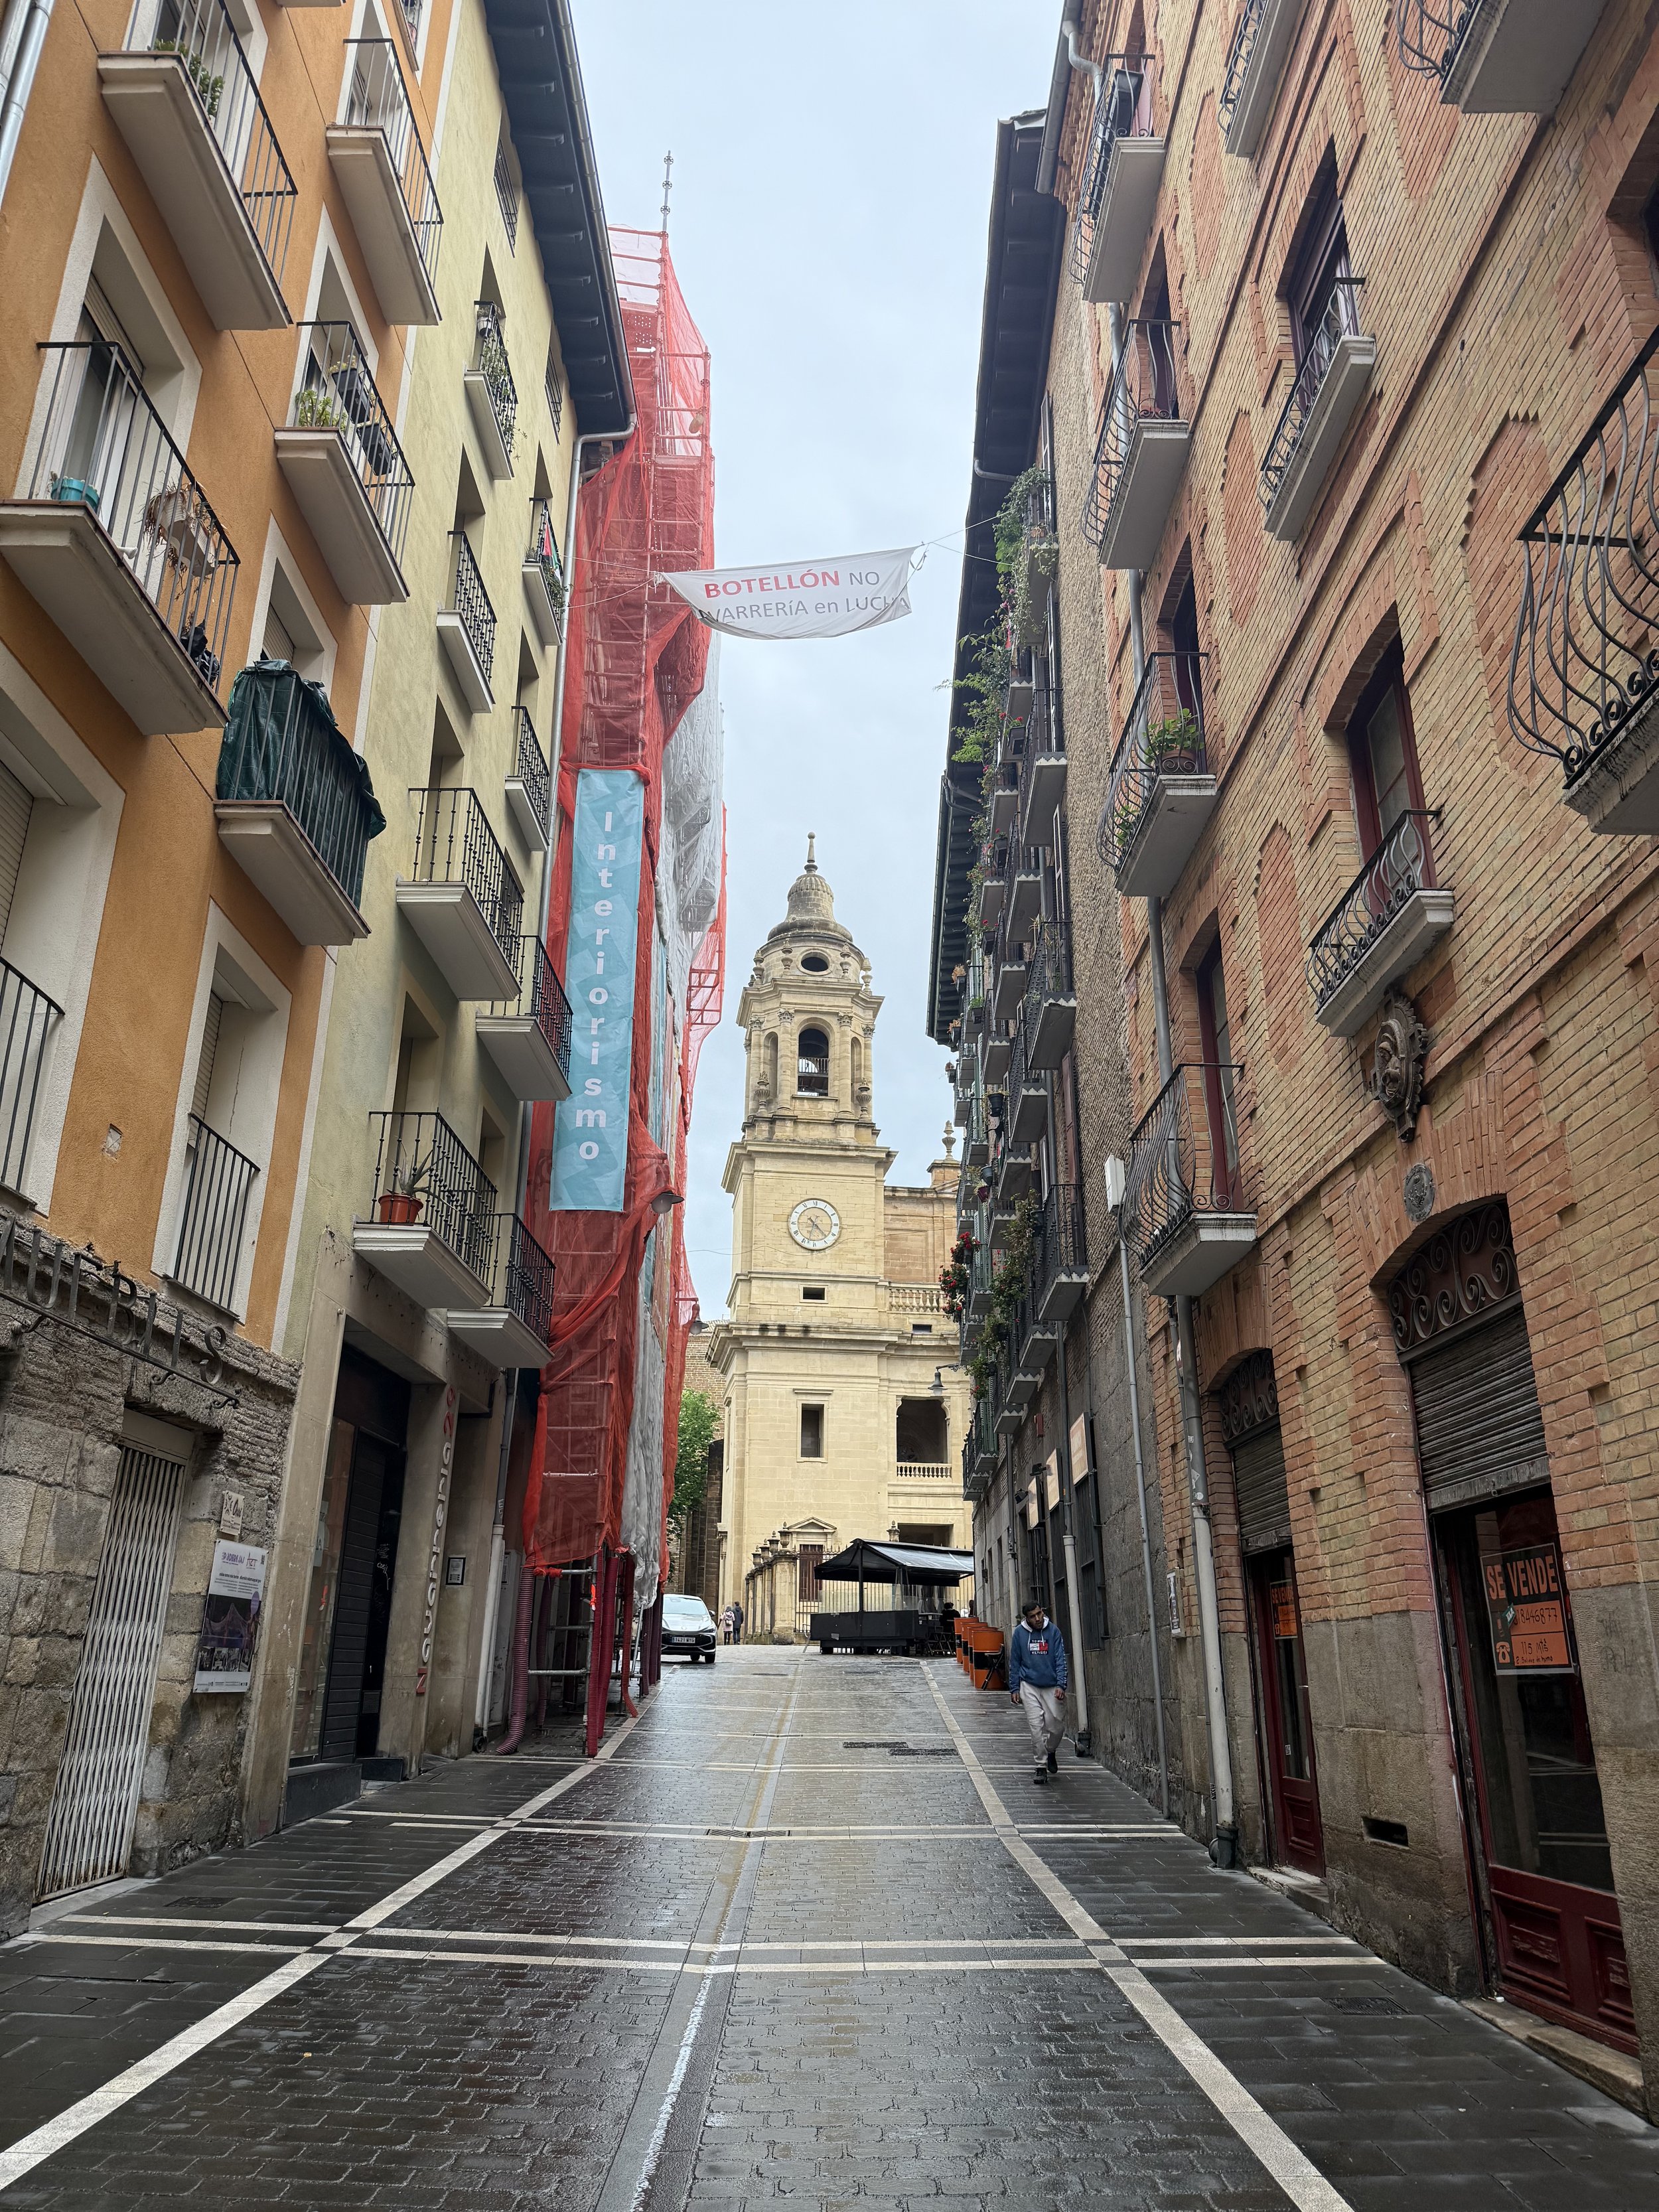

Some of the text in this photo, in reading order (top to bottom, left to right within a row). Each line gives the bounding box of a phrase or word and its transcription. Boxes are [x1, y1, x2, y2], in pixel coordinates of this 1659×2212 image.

[704, 569, 880, 599] BOTELLÓN NO
[815, 601, 838, 614] en
[575, 811, 616, 1161] Interiorismo
[1486, 1556, 1558, 1600] SE VENDE
[1520, 1641, 1533, 1655] 115
